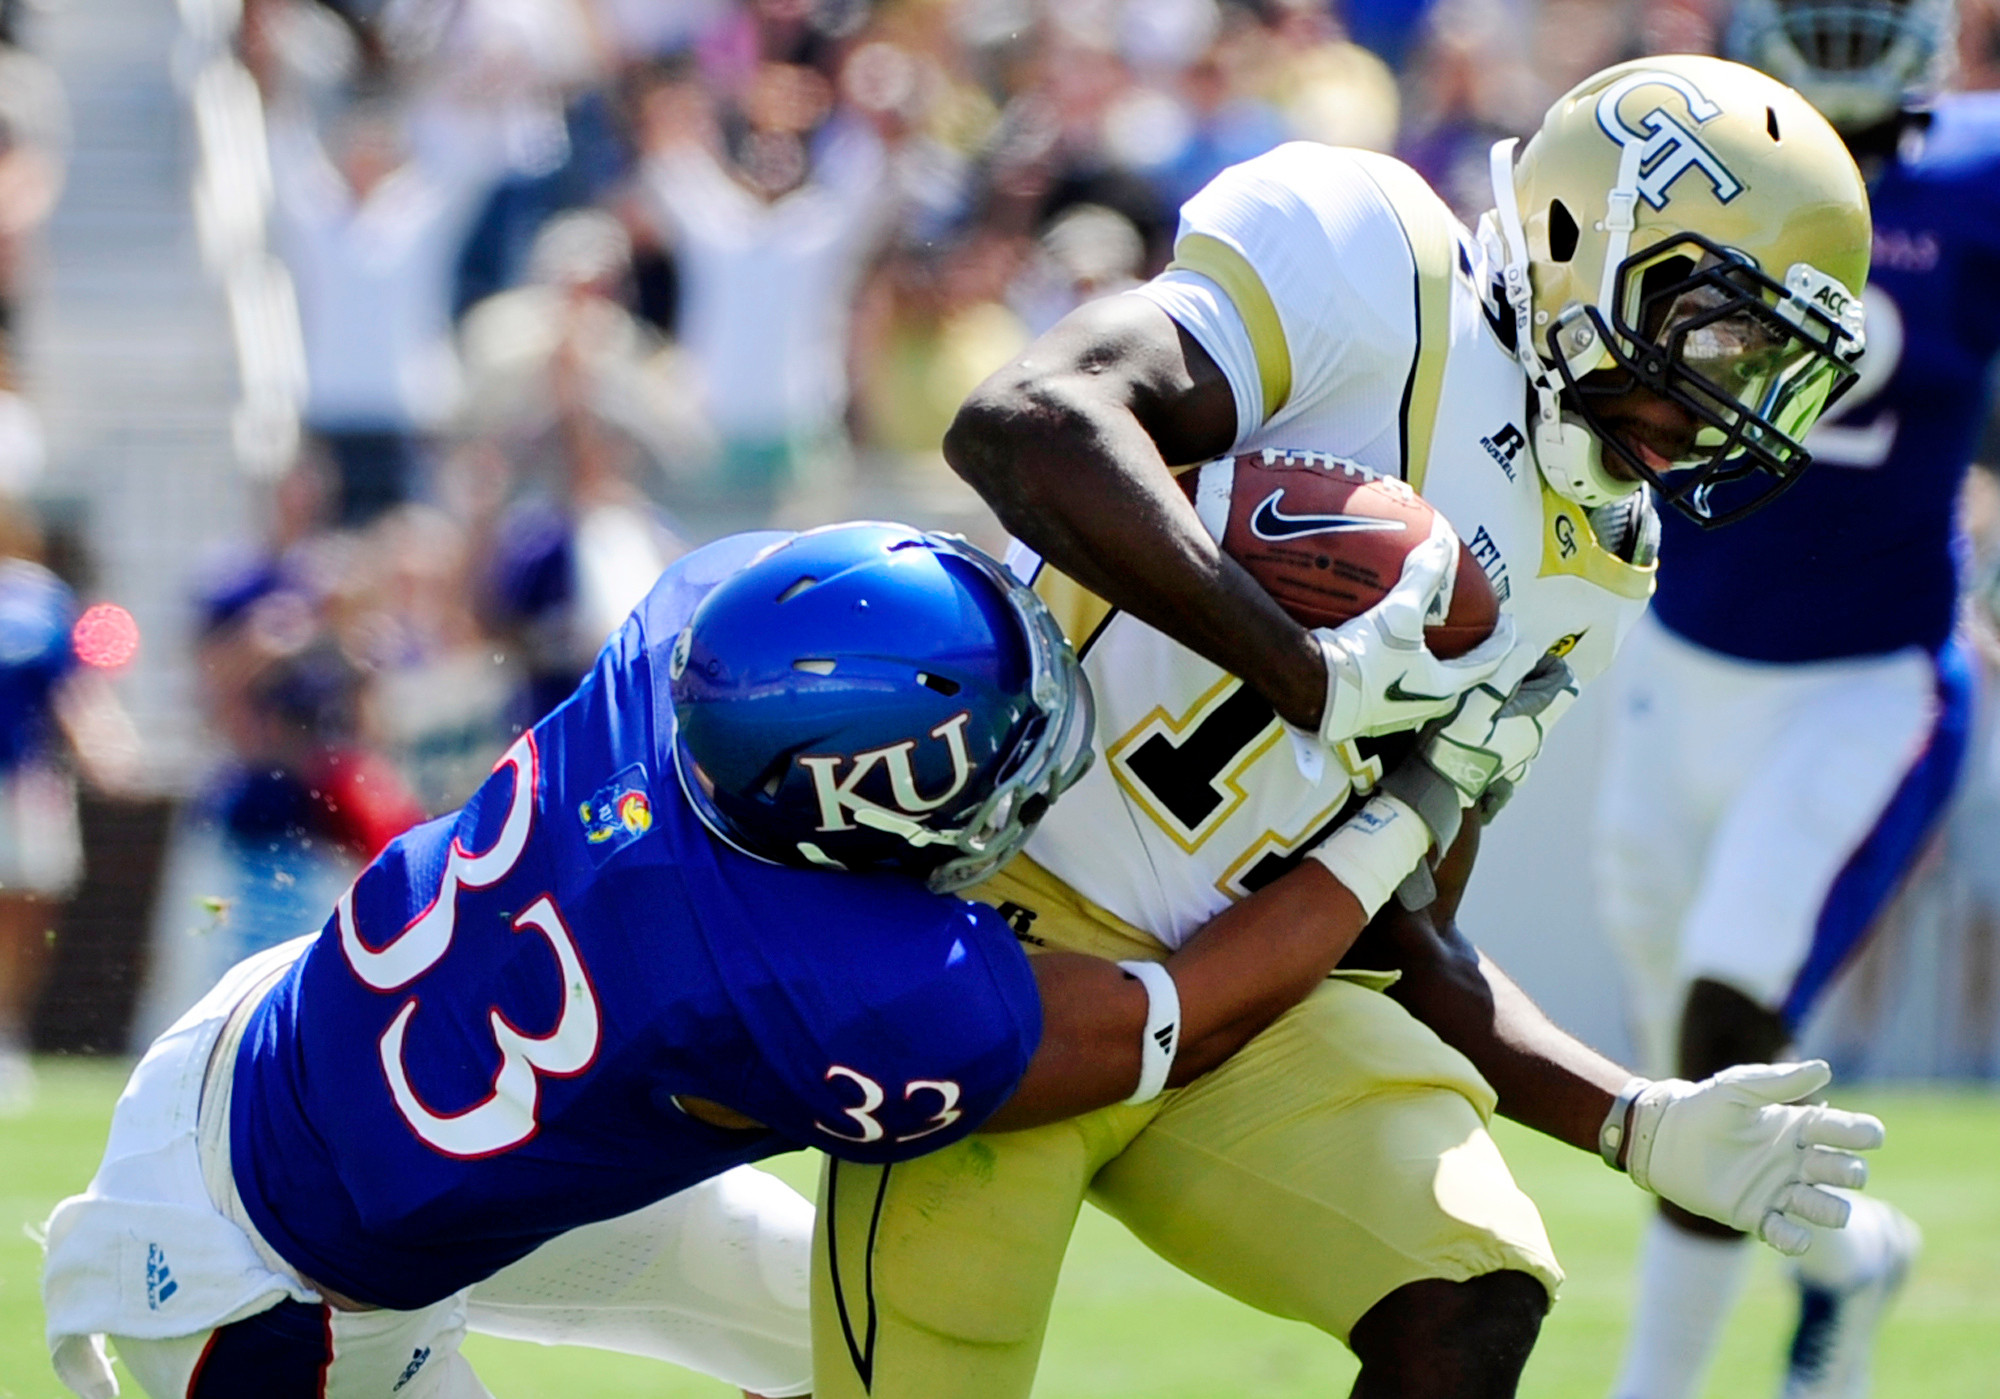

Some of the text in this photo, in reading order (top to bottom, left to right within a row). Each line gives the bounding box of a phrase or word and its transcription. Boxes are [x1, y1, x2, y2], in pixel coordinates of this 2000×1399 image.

[1595, 70, 1744, 213] GT
[1814, 285, 1850, 317] ACC
[1479, 436, 1517, 484] RUSSELL
[1555, 514, 1577, 559] GT
[798, 711, 970, 832] KU
[337, 728, 601, 1161] 33
[813, 1064, 963, 1143] 33
[146, 1243, 160, 1311] adidas
